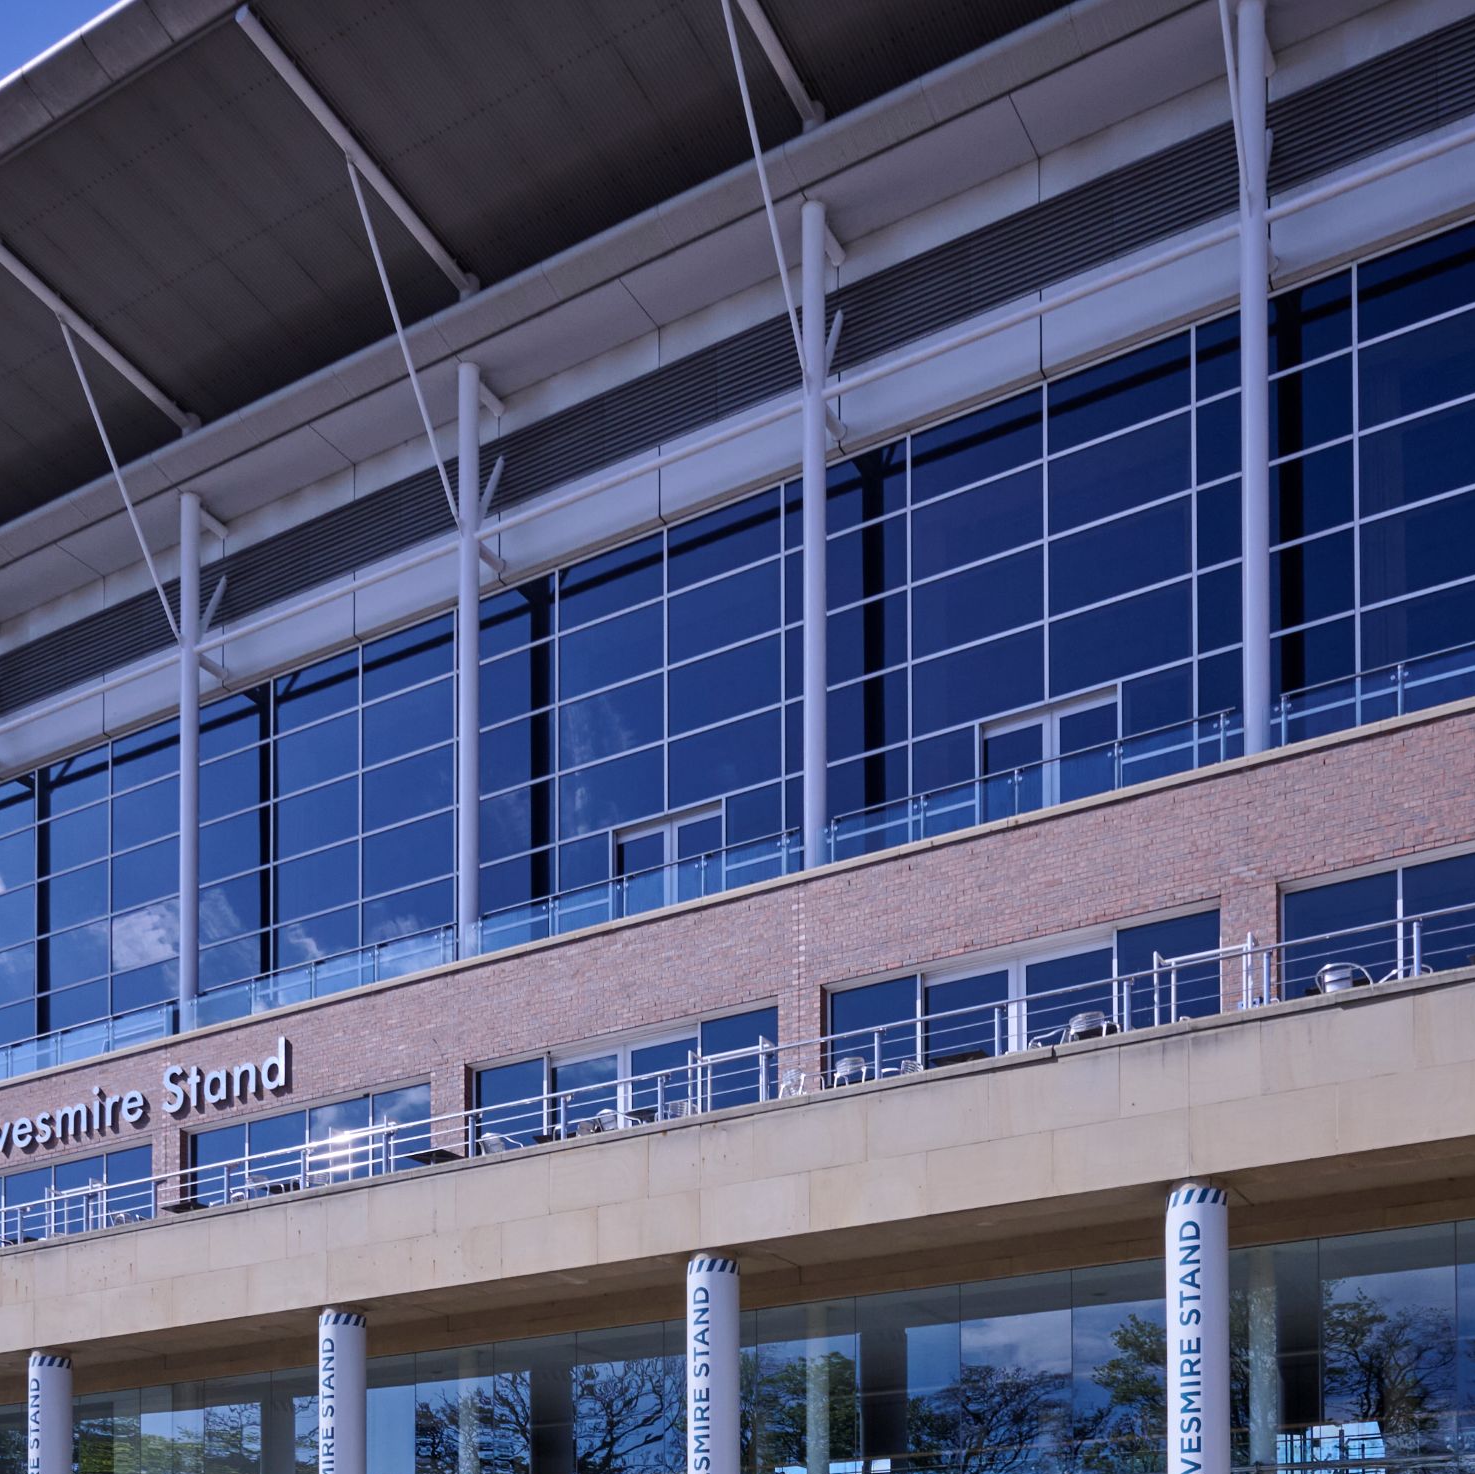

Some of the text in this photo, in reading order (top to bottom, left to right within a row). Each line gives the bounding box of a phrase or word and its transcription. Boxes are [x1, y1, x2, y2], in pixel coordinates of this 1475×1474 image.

[162, 1036, 286, 1113] Stand
[1179, 1220, 1201, 1326] STAND
[693, 1286, 710, 1377] STAND
[29, 1378, 41, 1450] STAND
[321, 1337, 335, 1418] STAND
